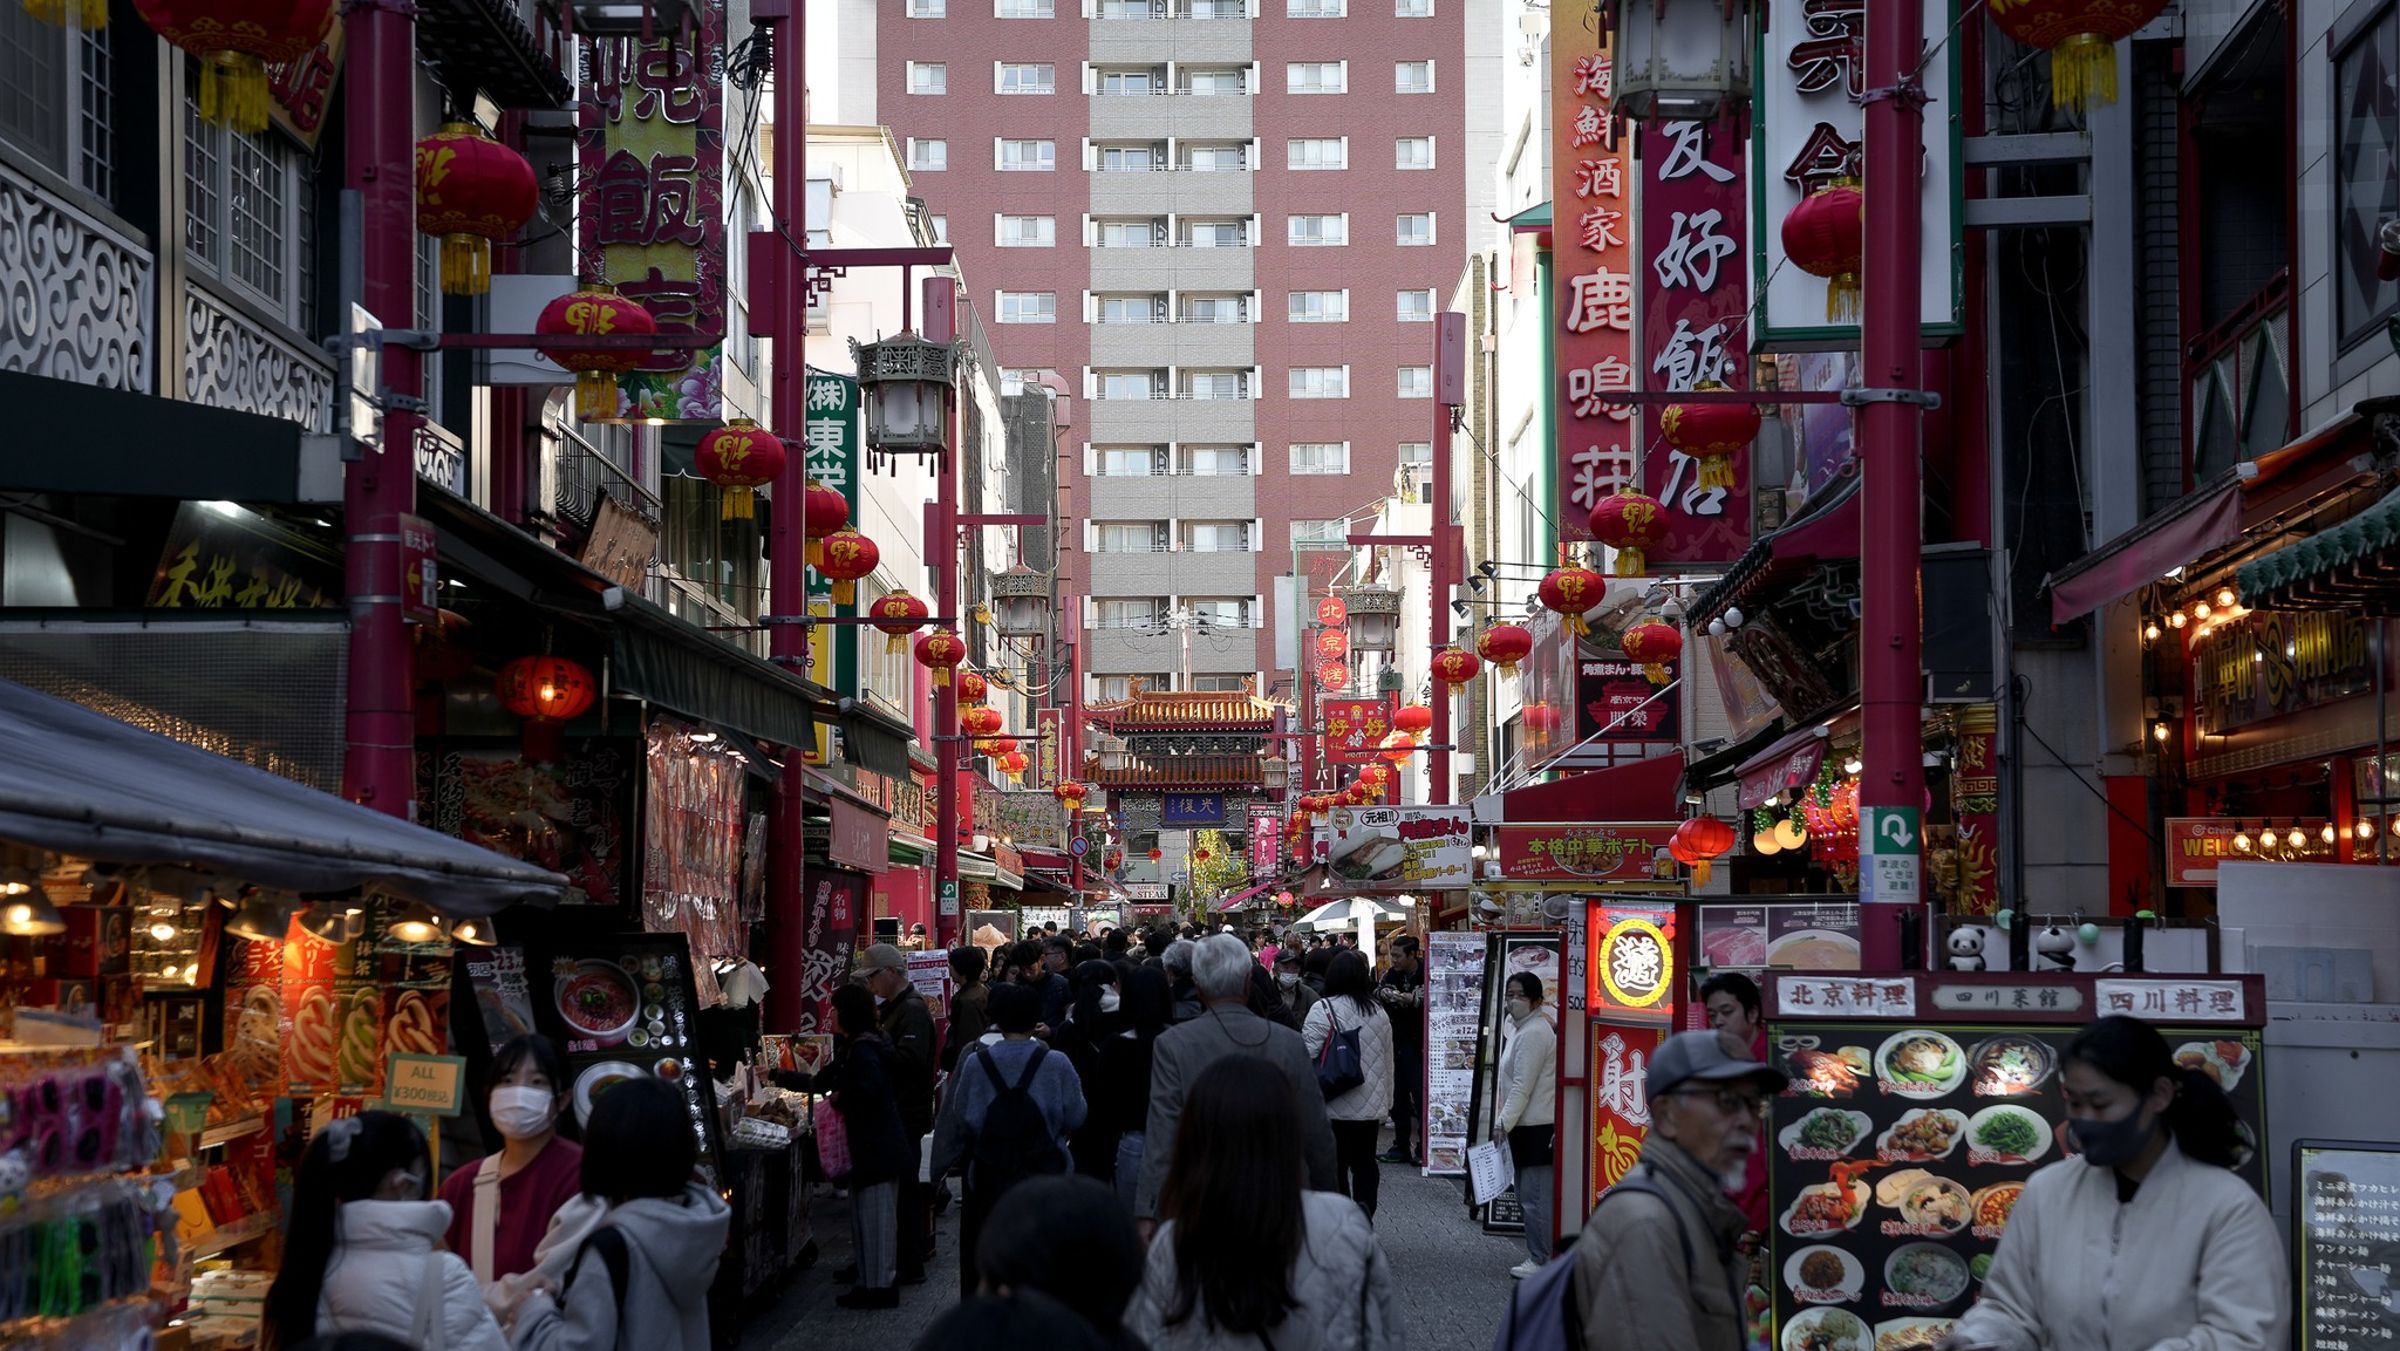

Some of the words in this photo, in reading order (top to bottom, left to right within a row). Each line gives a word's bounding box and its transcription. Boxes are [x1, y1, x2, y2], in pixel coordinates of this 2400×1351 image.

[1573, 54, 1624, 252] 海鮮酒家
[1653, 120, 1738, 516] 友好飯店
[1566, 266, 1633, 512] 鹿鳴荘
[1528, 837, 1653, 856] 本格中華ポテト
[1137, 890, 1167, 899] STEAK
[1789, 984, 1910, 1007] 北京料理
[1955, 988, 2060, 1009] 四川菜館
[2108, 988, 2237, 1012] 四川料理
[410, 1066, 436, 1080] ALL
